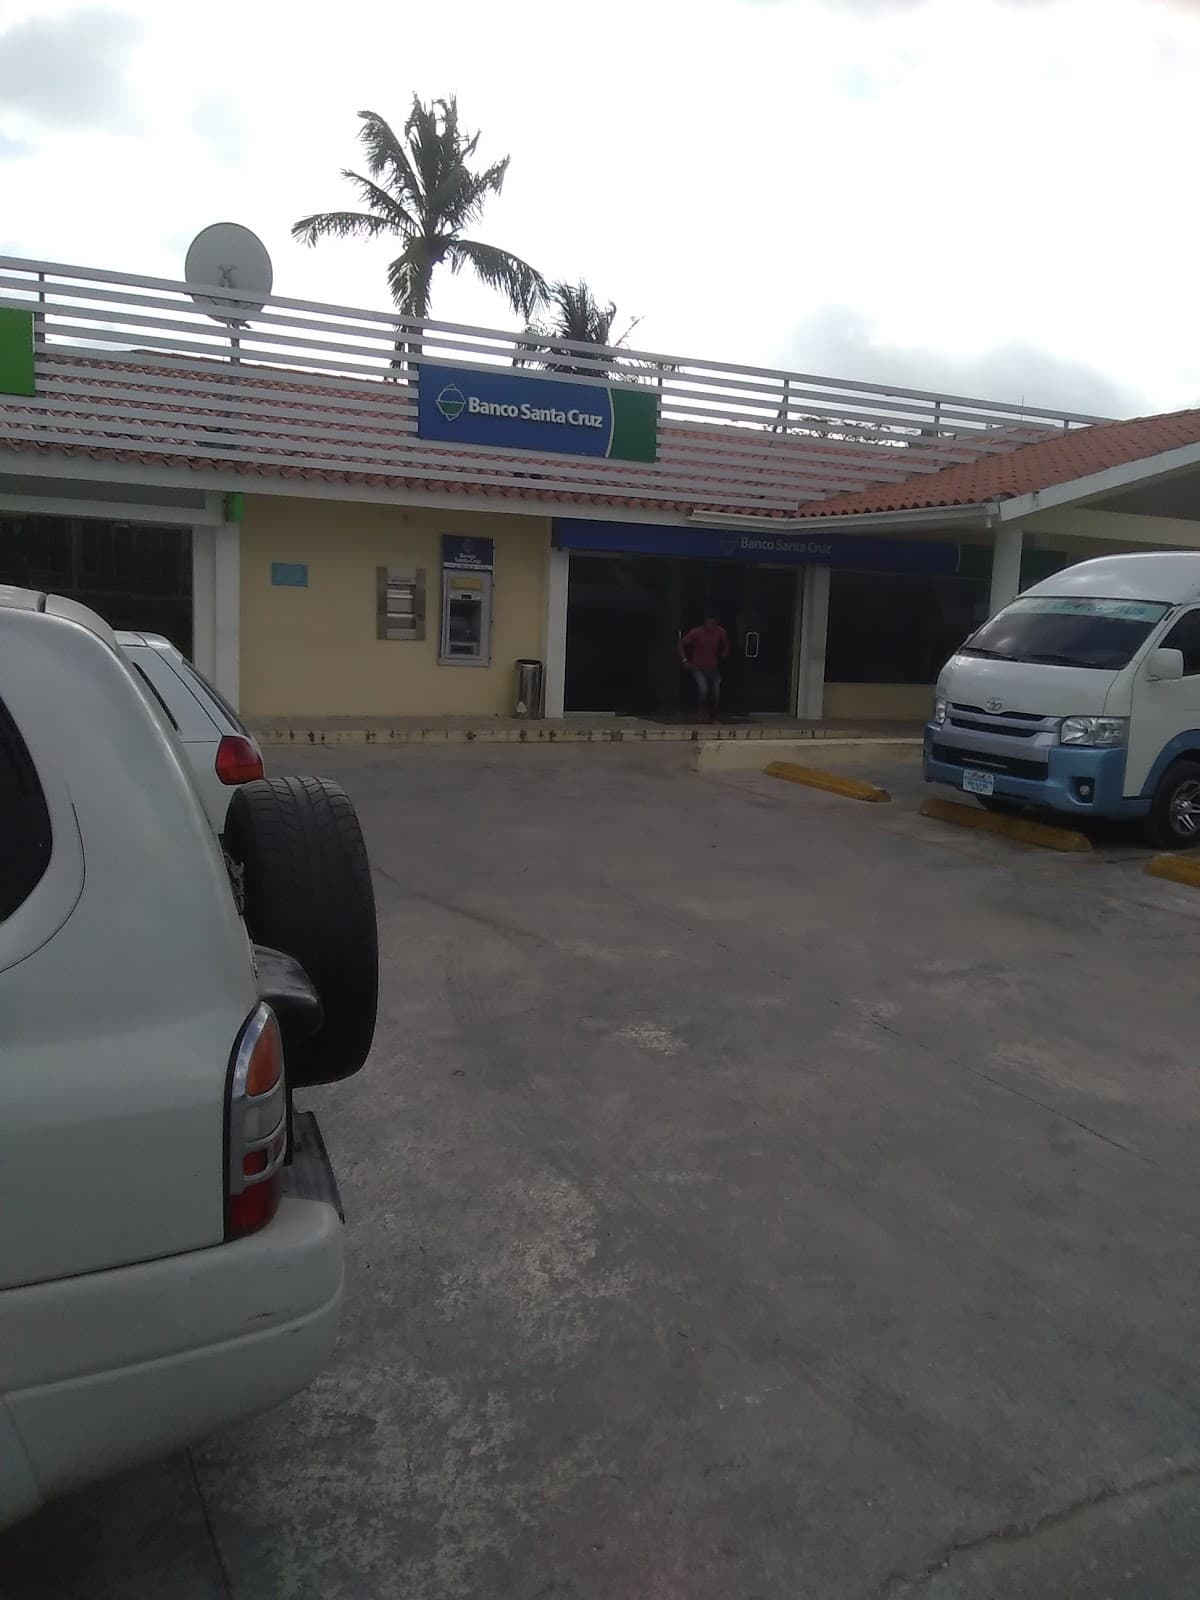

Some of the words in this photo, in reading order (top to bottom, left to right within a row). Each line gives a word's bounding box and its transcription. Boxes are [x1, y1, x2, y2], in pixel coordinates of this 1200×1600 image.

[468, 397, 518, 417] Banco
[520, 404, 565, 424] Santa
[567, 409, 603, 428] Cruz
[741, 536, 774, 550] Banco
[776, 538, 806, 552] Santa
[807, 542, 833, 554] Cruz
